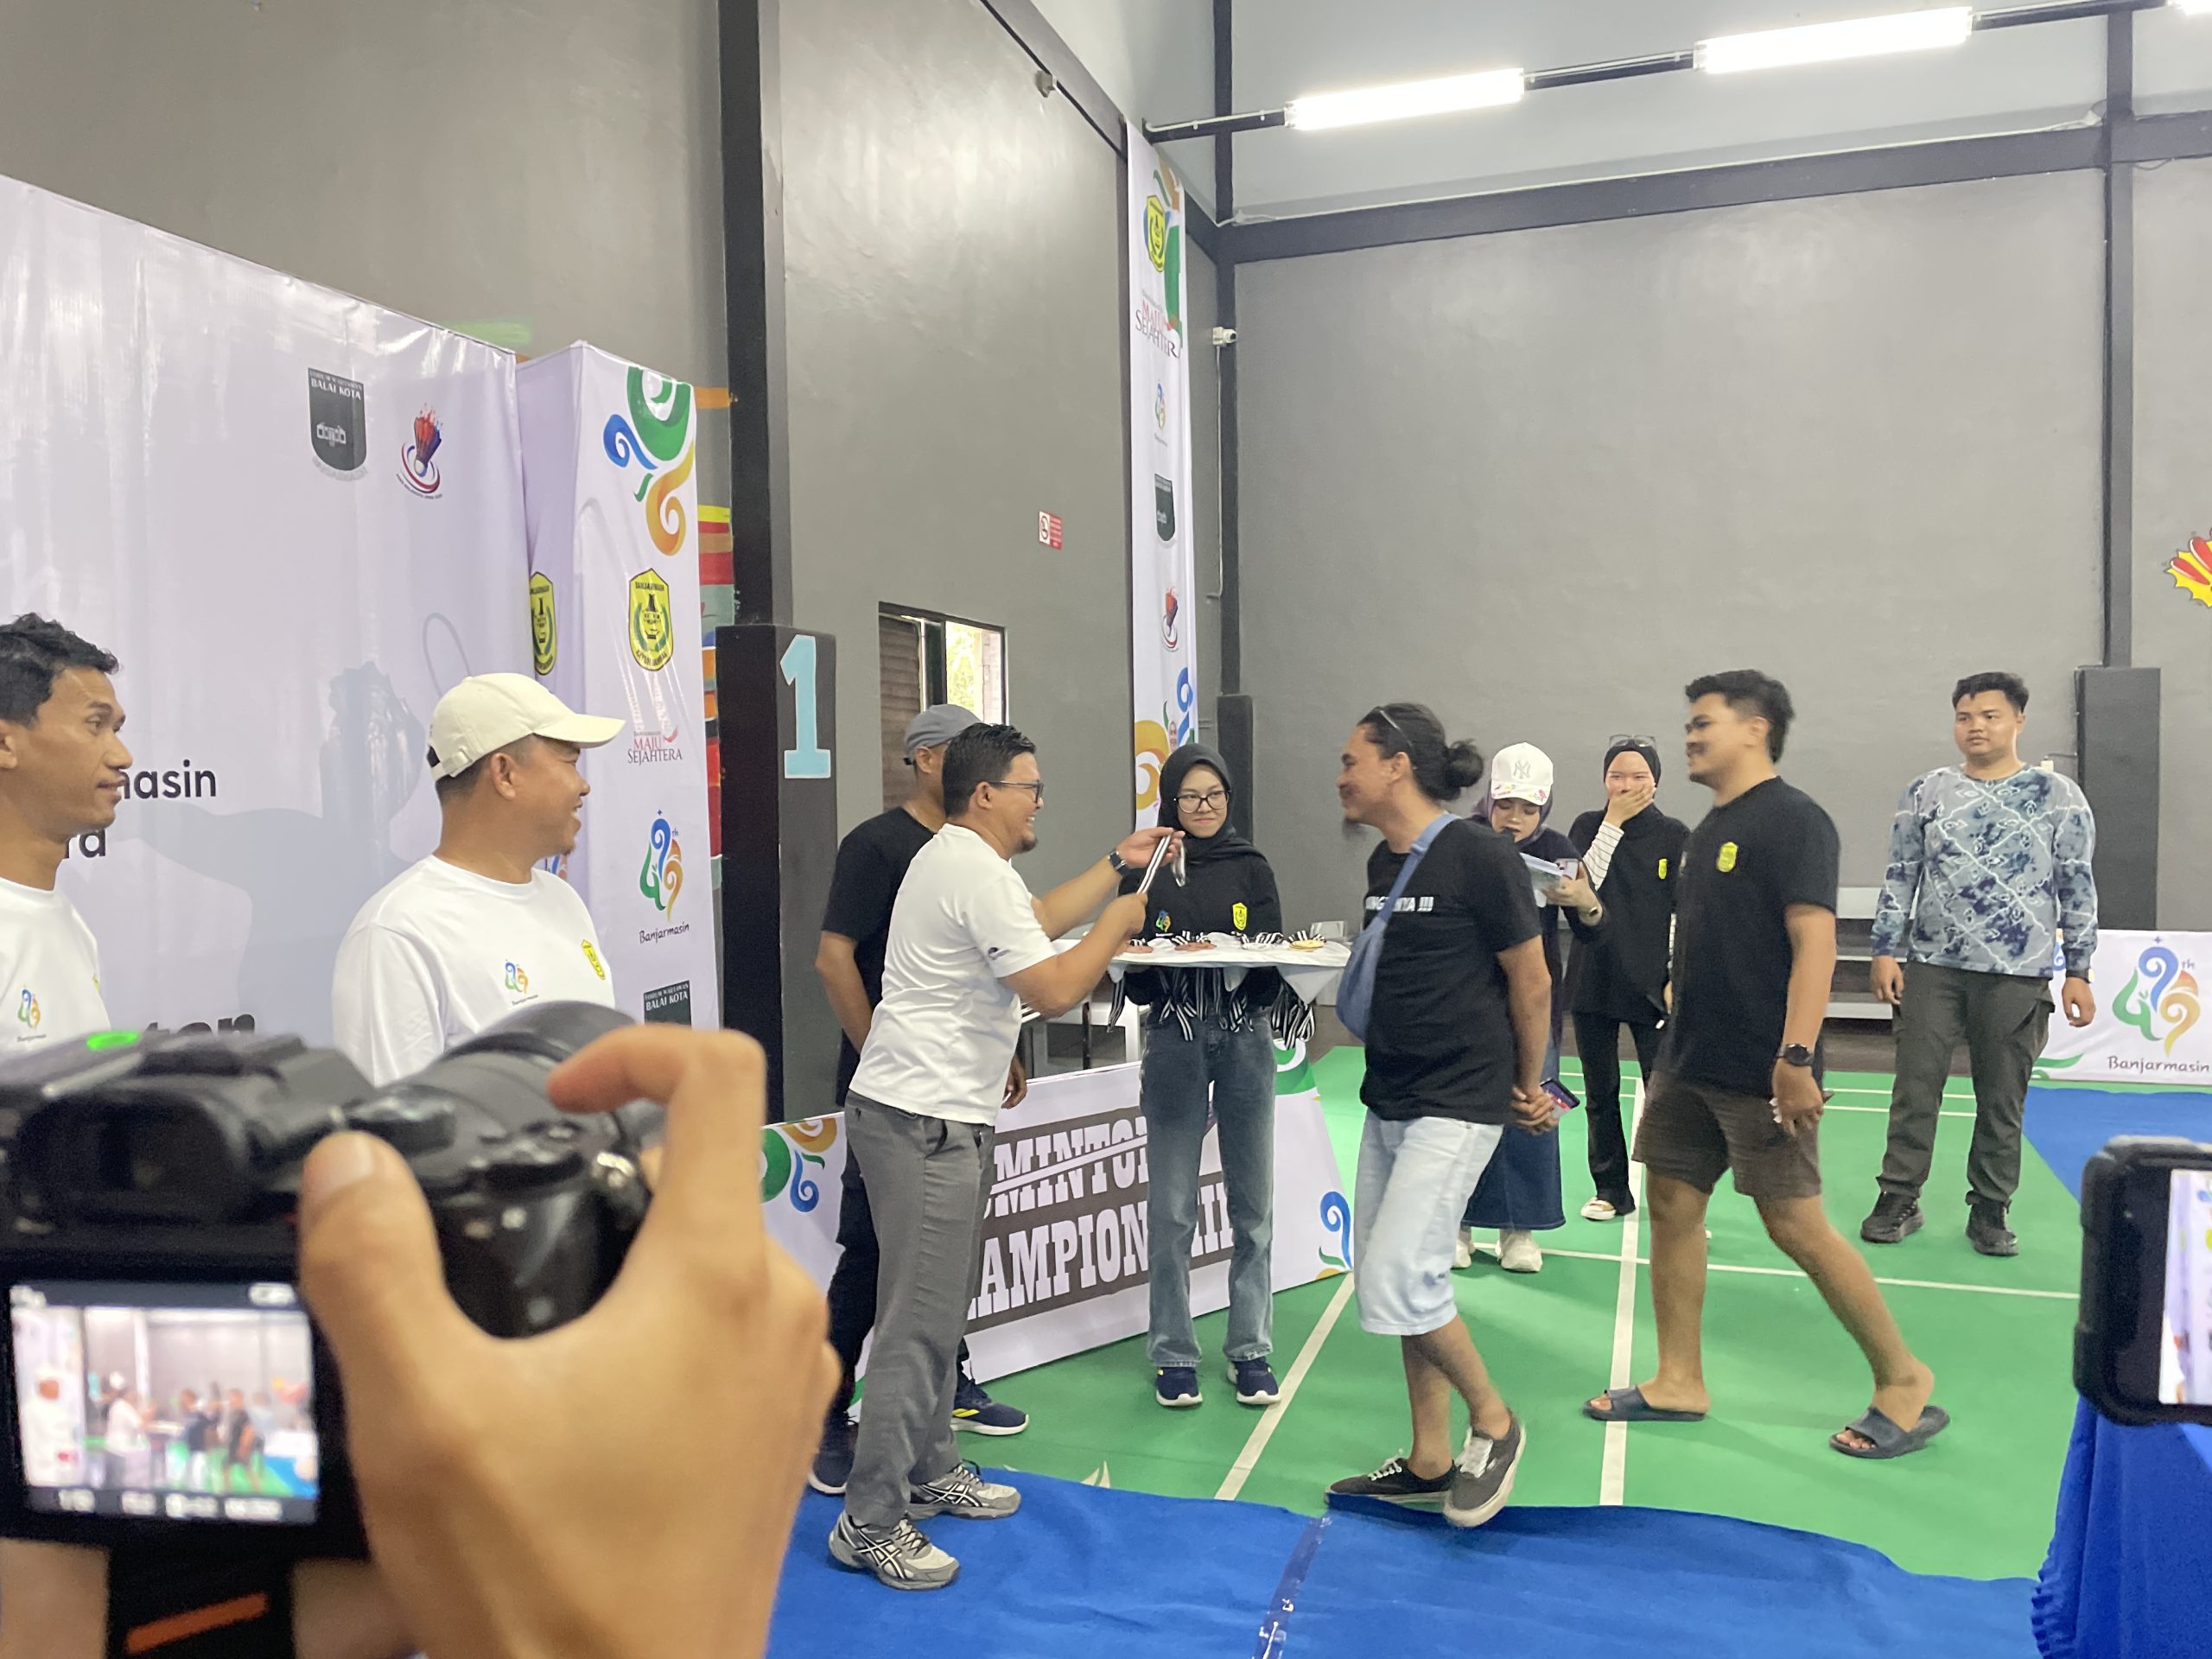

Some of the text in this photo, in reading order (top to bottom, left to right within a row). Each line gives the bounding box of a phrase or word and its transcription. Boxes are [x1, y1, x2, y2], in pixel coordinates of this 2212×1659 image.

[779, 633, 831, 779] 1
[633, 735, 661, 751] MAJU
[627, 748, 683, 766] SEJAHTERA
[639, 921, 690, 944] Banjarmasin
[645, 990, 688, 1011] BALAI KOTA
[2108, 1055, 2209, 1073] Banjarmasin
[983, 1116, 1149, 1219] MINTO
